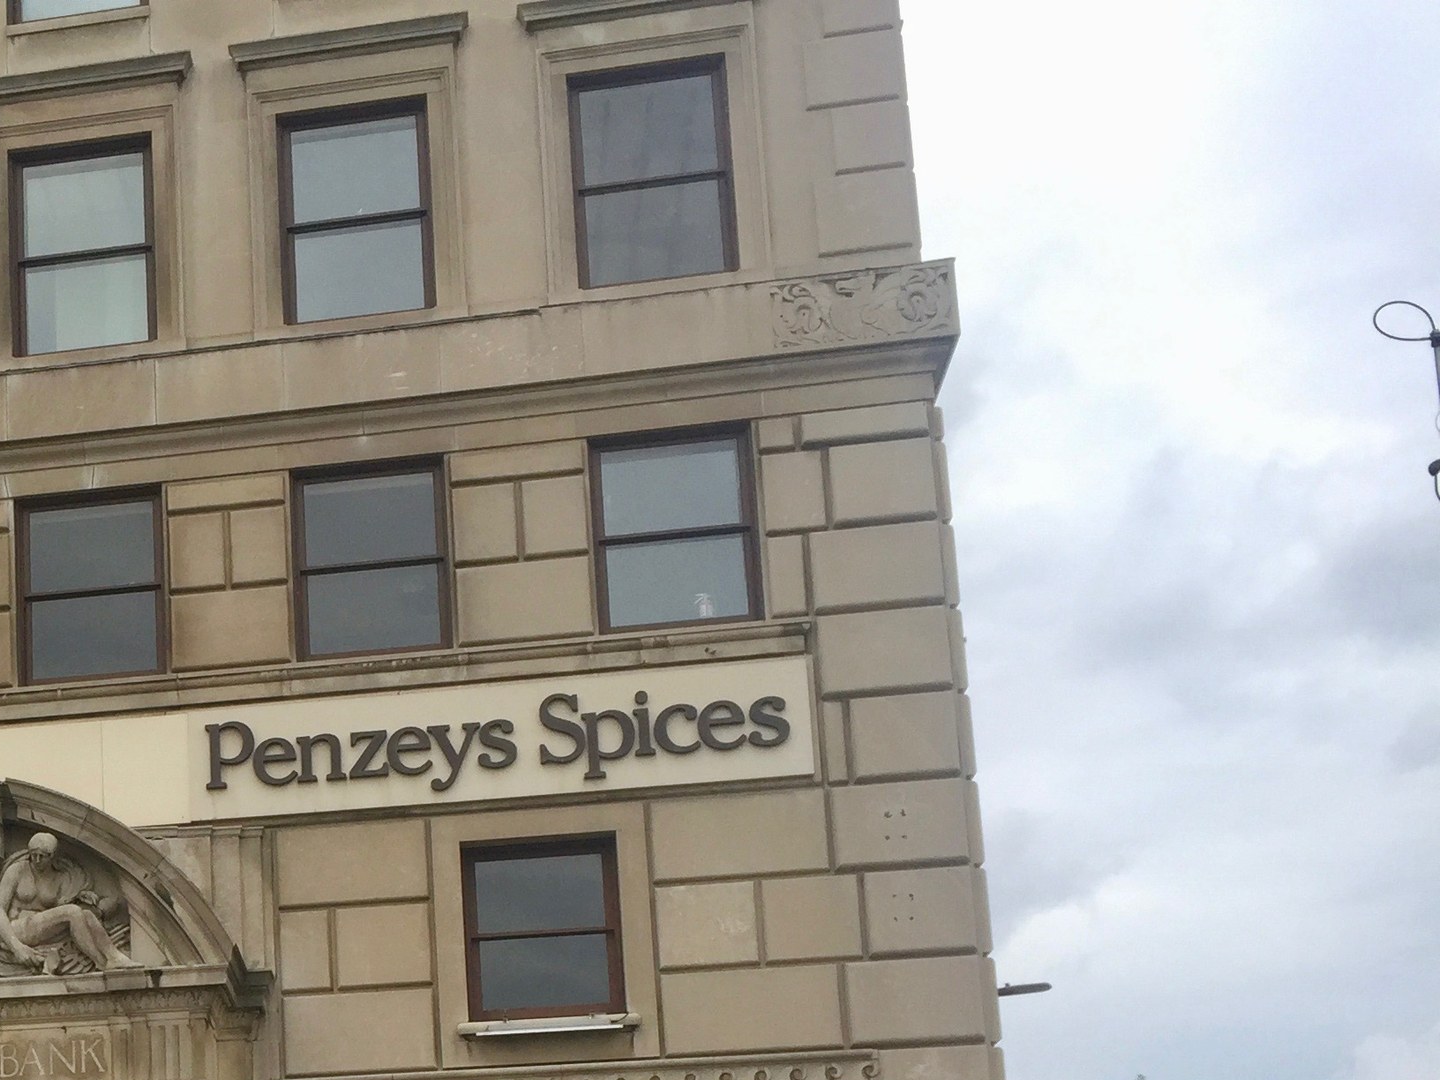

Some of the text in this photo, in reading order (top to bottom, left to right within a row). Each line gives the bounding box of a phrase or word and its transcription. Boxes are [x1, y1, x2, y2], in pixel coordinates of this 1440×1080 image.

[205, 690, 791, 792] Penzeys Spices
[0, 1038, 106, 1079] BANK
